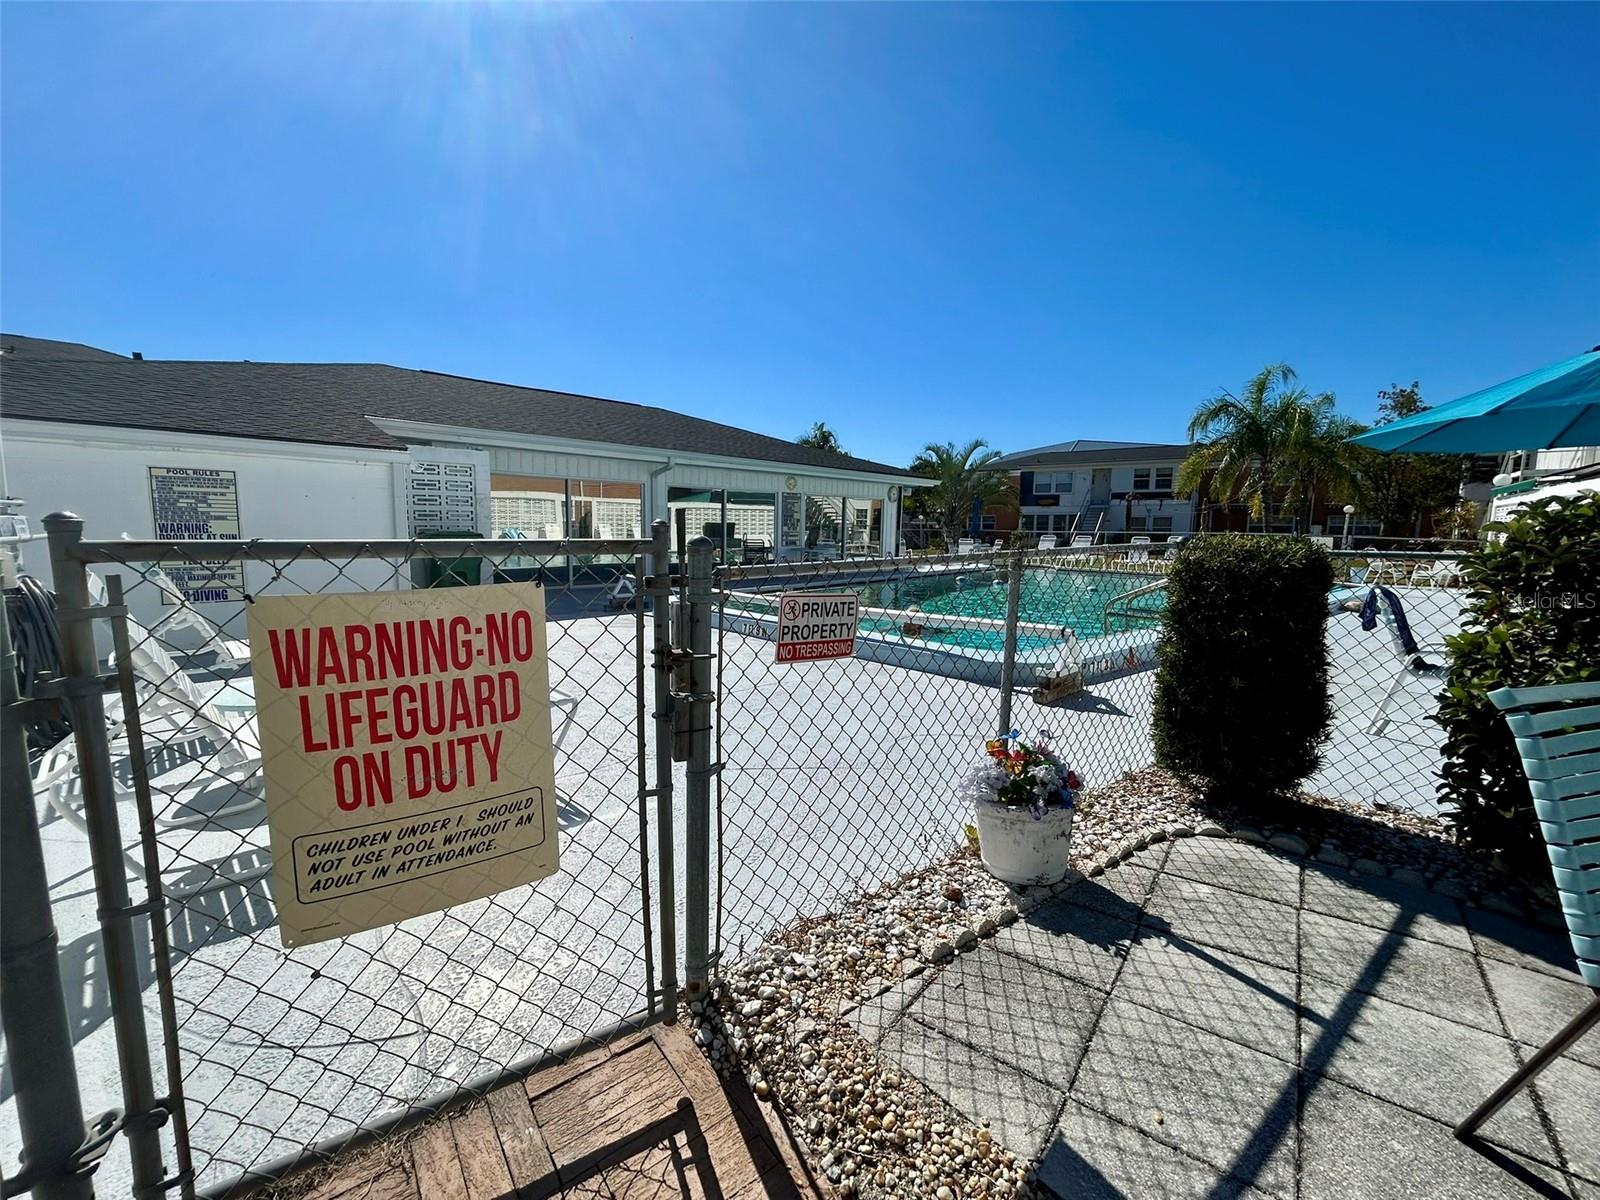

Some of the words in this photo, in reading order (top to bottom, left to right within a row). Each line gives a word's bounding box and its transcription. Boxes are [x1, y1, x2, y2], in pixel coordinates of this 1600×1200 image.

[158, 522, 212, 534] WARNING:
[192, 589, 229, 602] DIVING
[801, 602, 855, 618] PRIVATE
[779, 645, 793, 659] NO
[795, 641, 852, 657] TRESPASSING
[781, 622, 854, 641] PROPERTY
[299, 670, 521, 753] LIFEGUARD
[333, 750, 394, 812] ON
[406, 730, 503, 800] DUTY
[307, 829, 391, 858] CHILDREN
[397, 817, 451, 841] UNDER
[477, 797, 534, 822] SHOULD
[307, 858, 344, 877] NOT
[352, 851, 384, 867] USE
[391, 839, 435, 858] POOL
[443, 819, 511, 847] WITHOUT
[515, 812, 535, 828] AN
[309, 870, 366, 894] ADULT
[372, 864, 391, 881] IN
[396, 838, 498, 875] ATTENDANCE.
